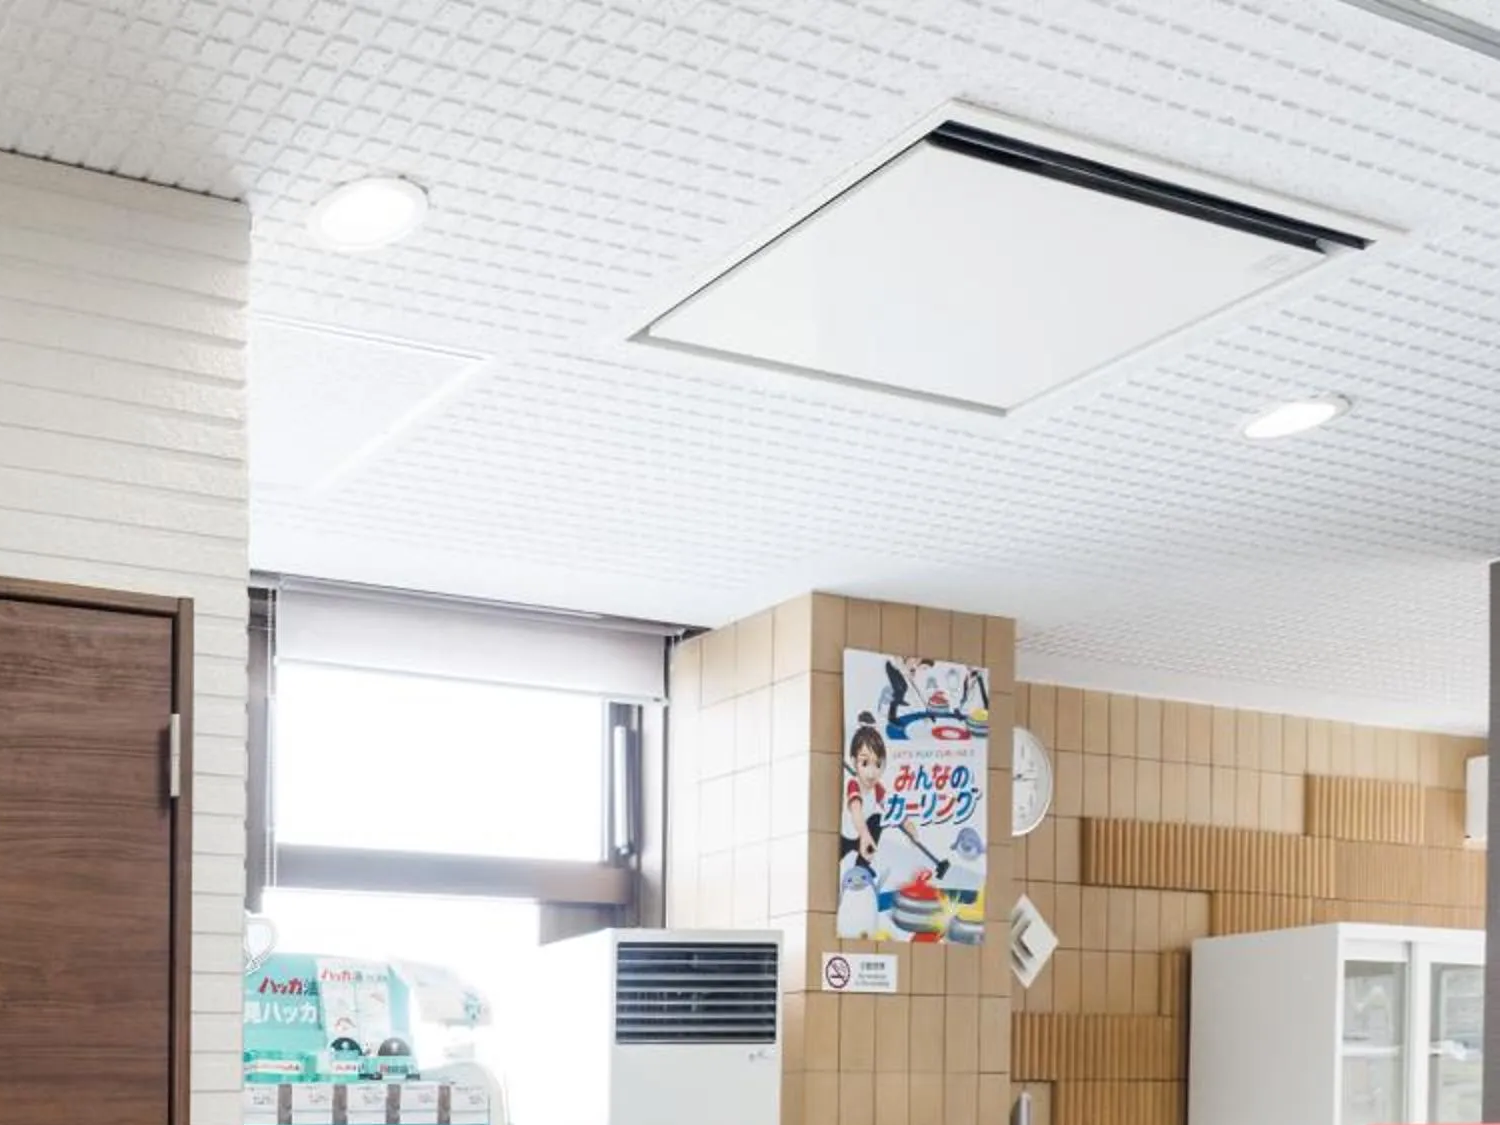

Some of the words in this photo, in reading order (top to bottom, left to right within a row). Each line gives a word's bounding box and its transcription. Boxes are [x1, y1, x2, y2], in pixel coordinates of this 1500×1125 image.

[893, 763, 970, 792] みんなの
[884, 787, 980, 822] カーリング
